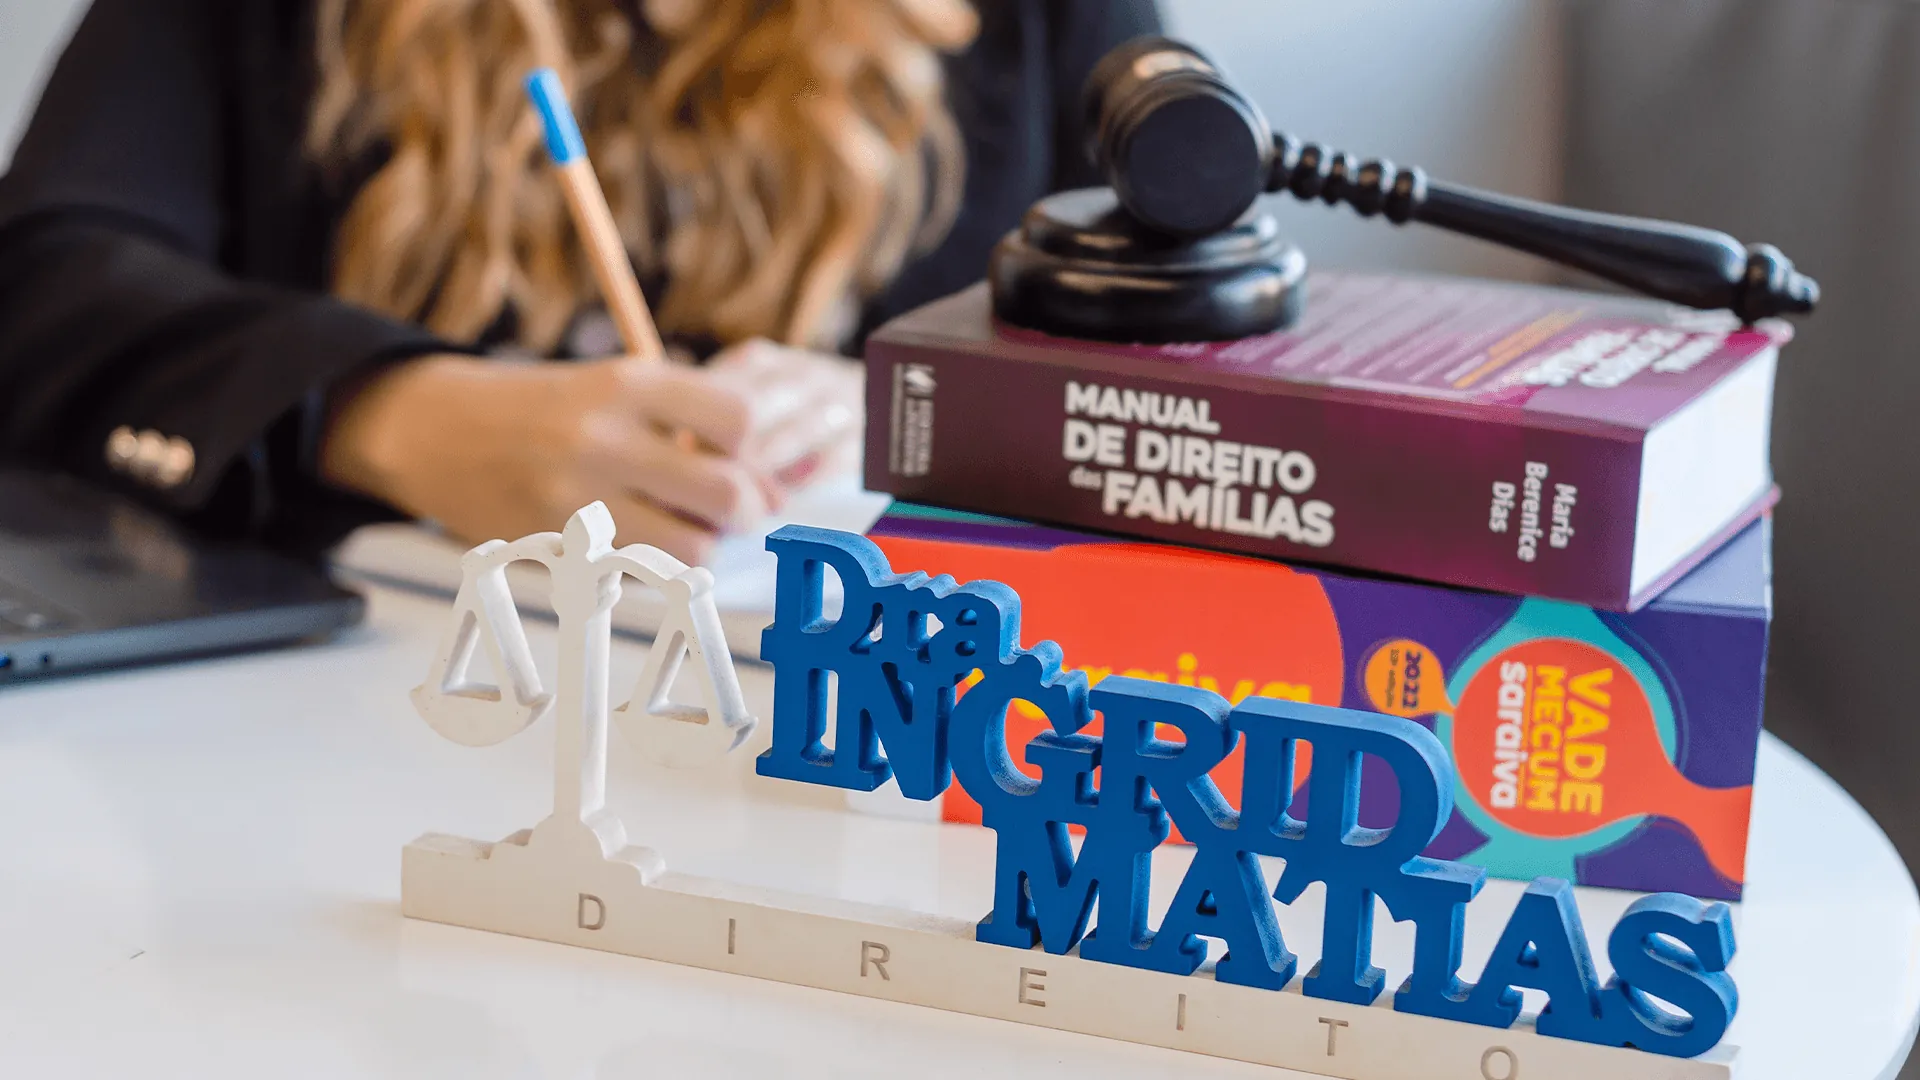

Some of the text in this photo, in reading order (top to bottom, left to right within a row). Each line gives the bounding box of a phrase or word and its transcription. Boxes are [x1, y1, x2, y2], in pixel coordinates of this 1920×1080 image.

[1062, 418, 1317, 494] DE DIREITO
[1064, 380, 1221, 434] MANUAL
[1102, 470, 1336, 547] FAMÍLIAS
[1488, 480, 1516, 534] Dias
[1517, 460, 1549, 562] Berenice
[1549, 482, 1578, 549] Maria
[761, 524, 1021, 663] Dra
[756, 640, 1455, 862] INGRID
[1489, 660, 1528, 809] saraiva
[1526, 664, 1567, 811] MECUM
[1561, 667, 1614, 816] VADE
[976, 818, 1739, 1058] MATIAS
